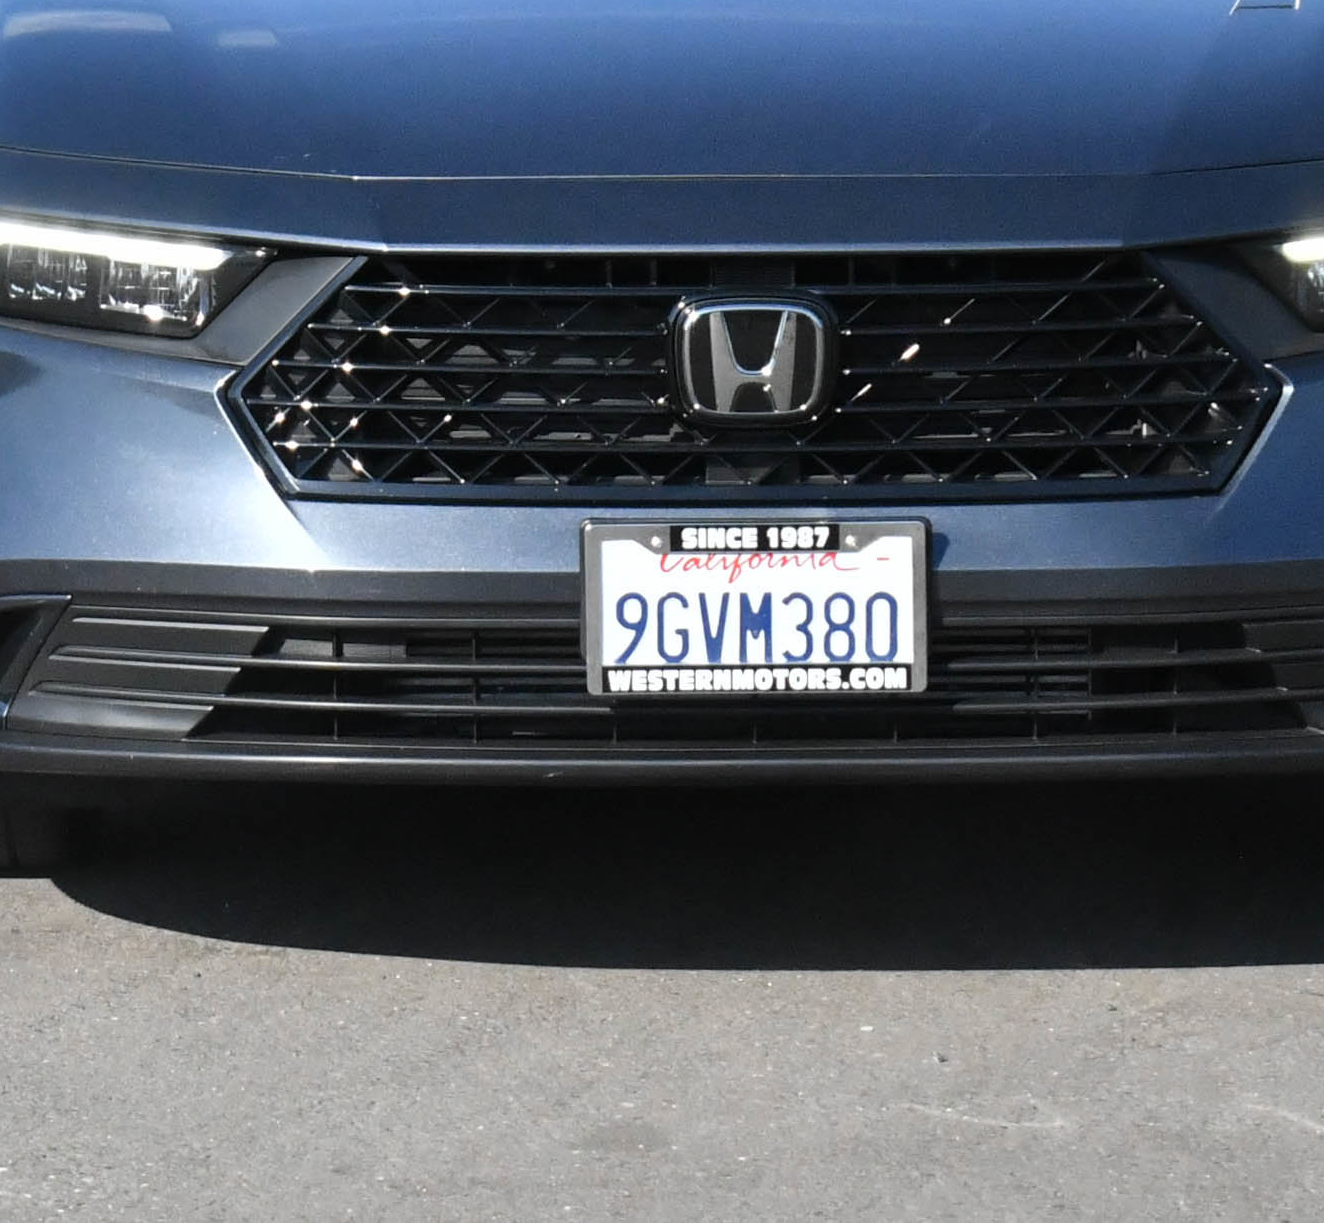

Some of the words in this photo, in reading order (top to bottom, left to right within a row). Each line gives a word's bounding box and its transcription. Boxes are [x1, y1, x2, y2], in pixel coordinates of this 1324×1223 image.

[681, 525, 758, 550] SINCE
[766, 525, 830, 549] 1987
[615, 591, 899, 664] 9GVM380
[607, 667, 907, 692] WESTERNMOTORS.COM
